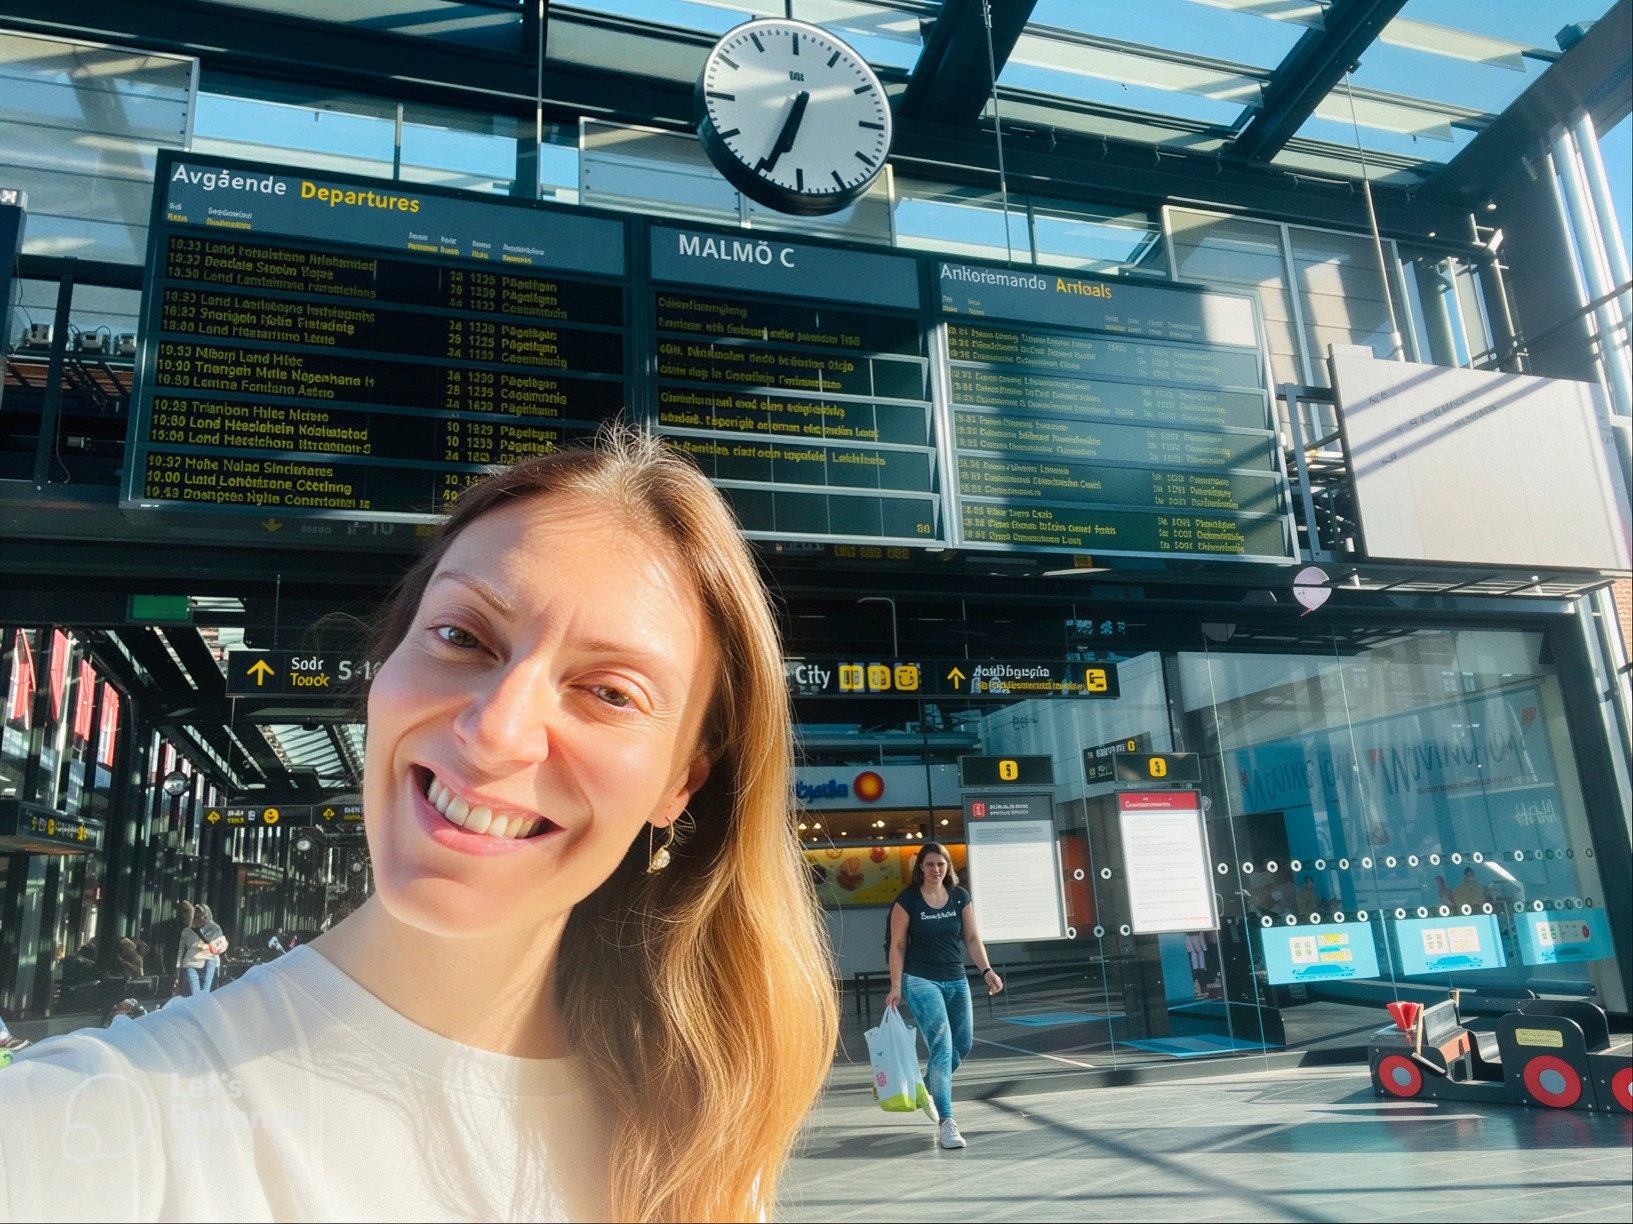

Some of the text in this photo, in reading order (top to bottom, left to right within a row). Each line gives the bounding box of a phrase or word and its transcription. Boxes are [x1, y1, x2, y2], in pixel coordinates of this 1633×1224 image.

[172, 164, 420, 213] Avgående Departures
[678, 233, 795, 268] MALMÖ C
[796, 664, 830, 690] City
